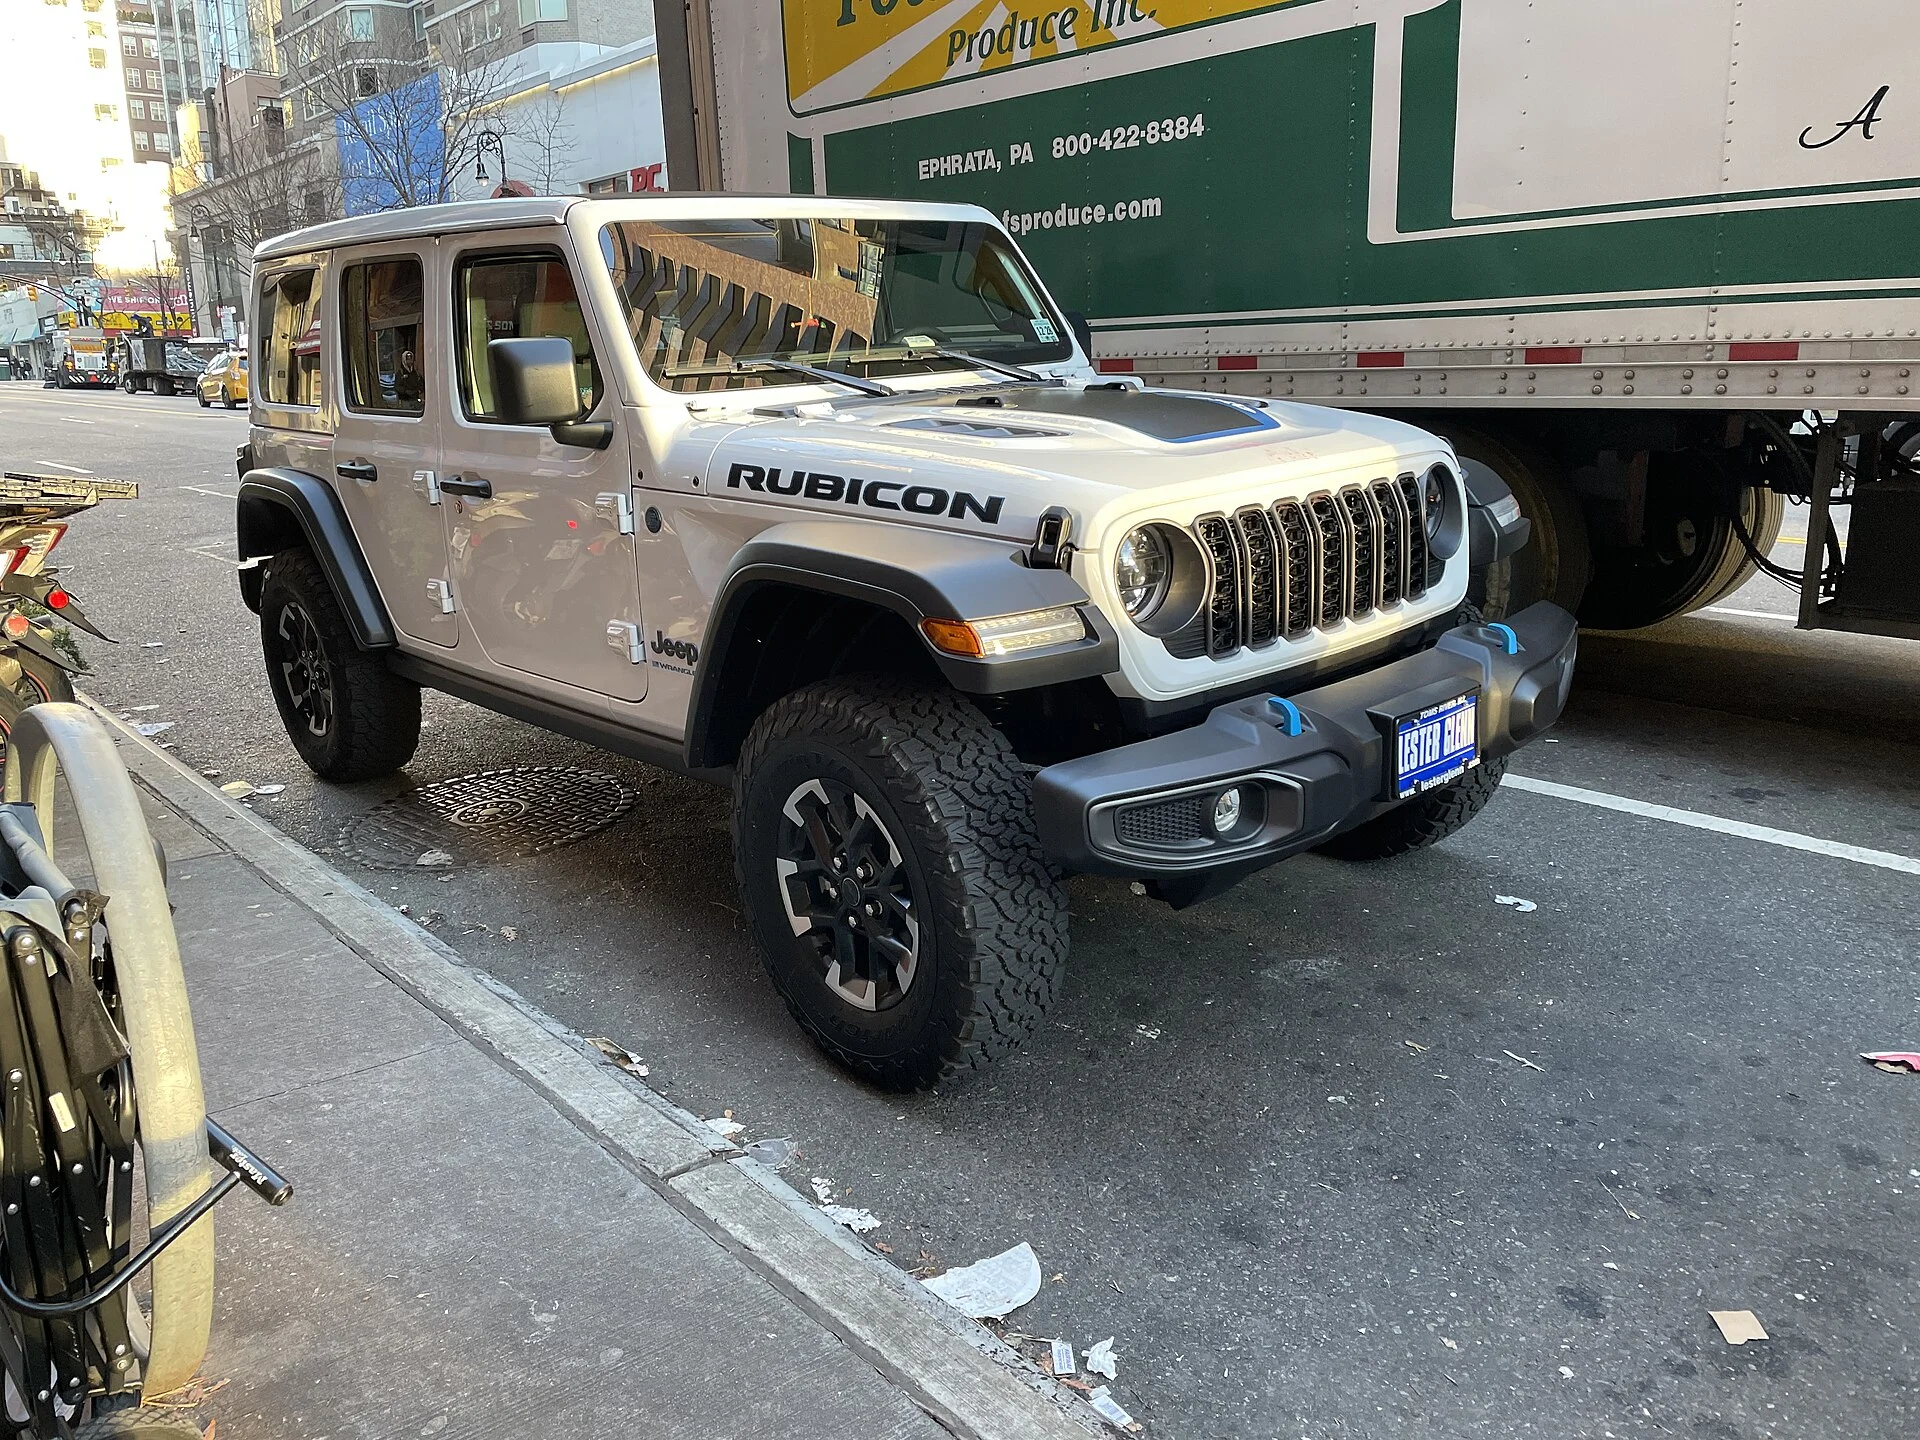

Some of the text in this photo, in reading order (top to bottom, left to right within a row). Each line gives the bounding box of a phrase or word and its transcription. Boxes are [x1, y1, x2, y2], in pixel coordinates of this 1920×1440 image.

[946, 6, 1079, 66] Produce
[1090, 0, 1157, 33] Inc.
[1798, 84, 1890, 149] A
[919, 148, 1002, 181] EPHRATA,
[1010, 142, 1034, 166] PA
[726, 462, 1006, 525] RUBICON
[651, 630, 698, 666] Jeep
[1398, 706, 1475, 775] LESTER GLENN
[229, 1153, 268, 1185] Master
